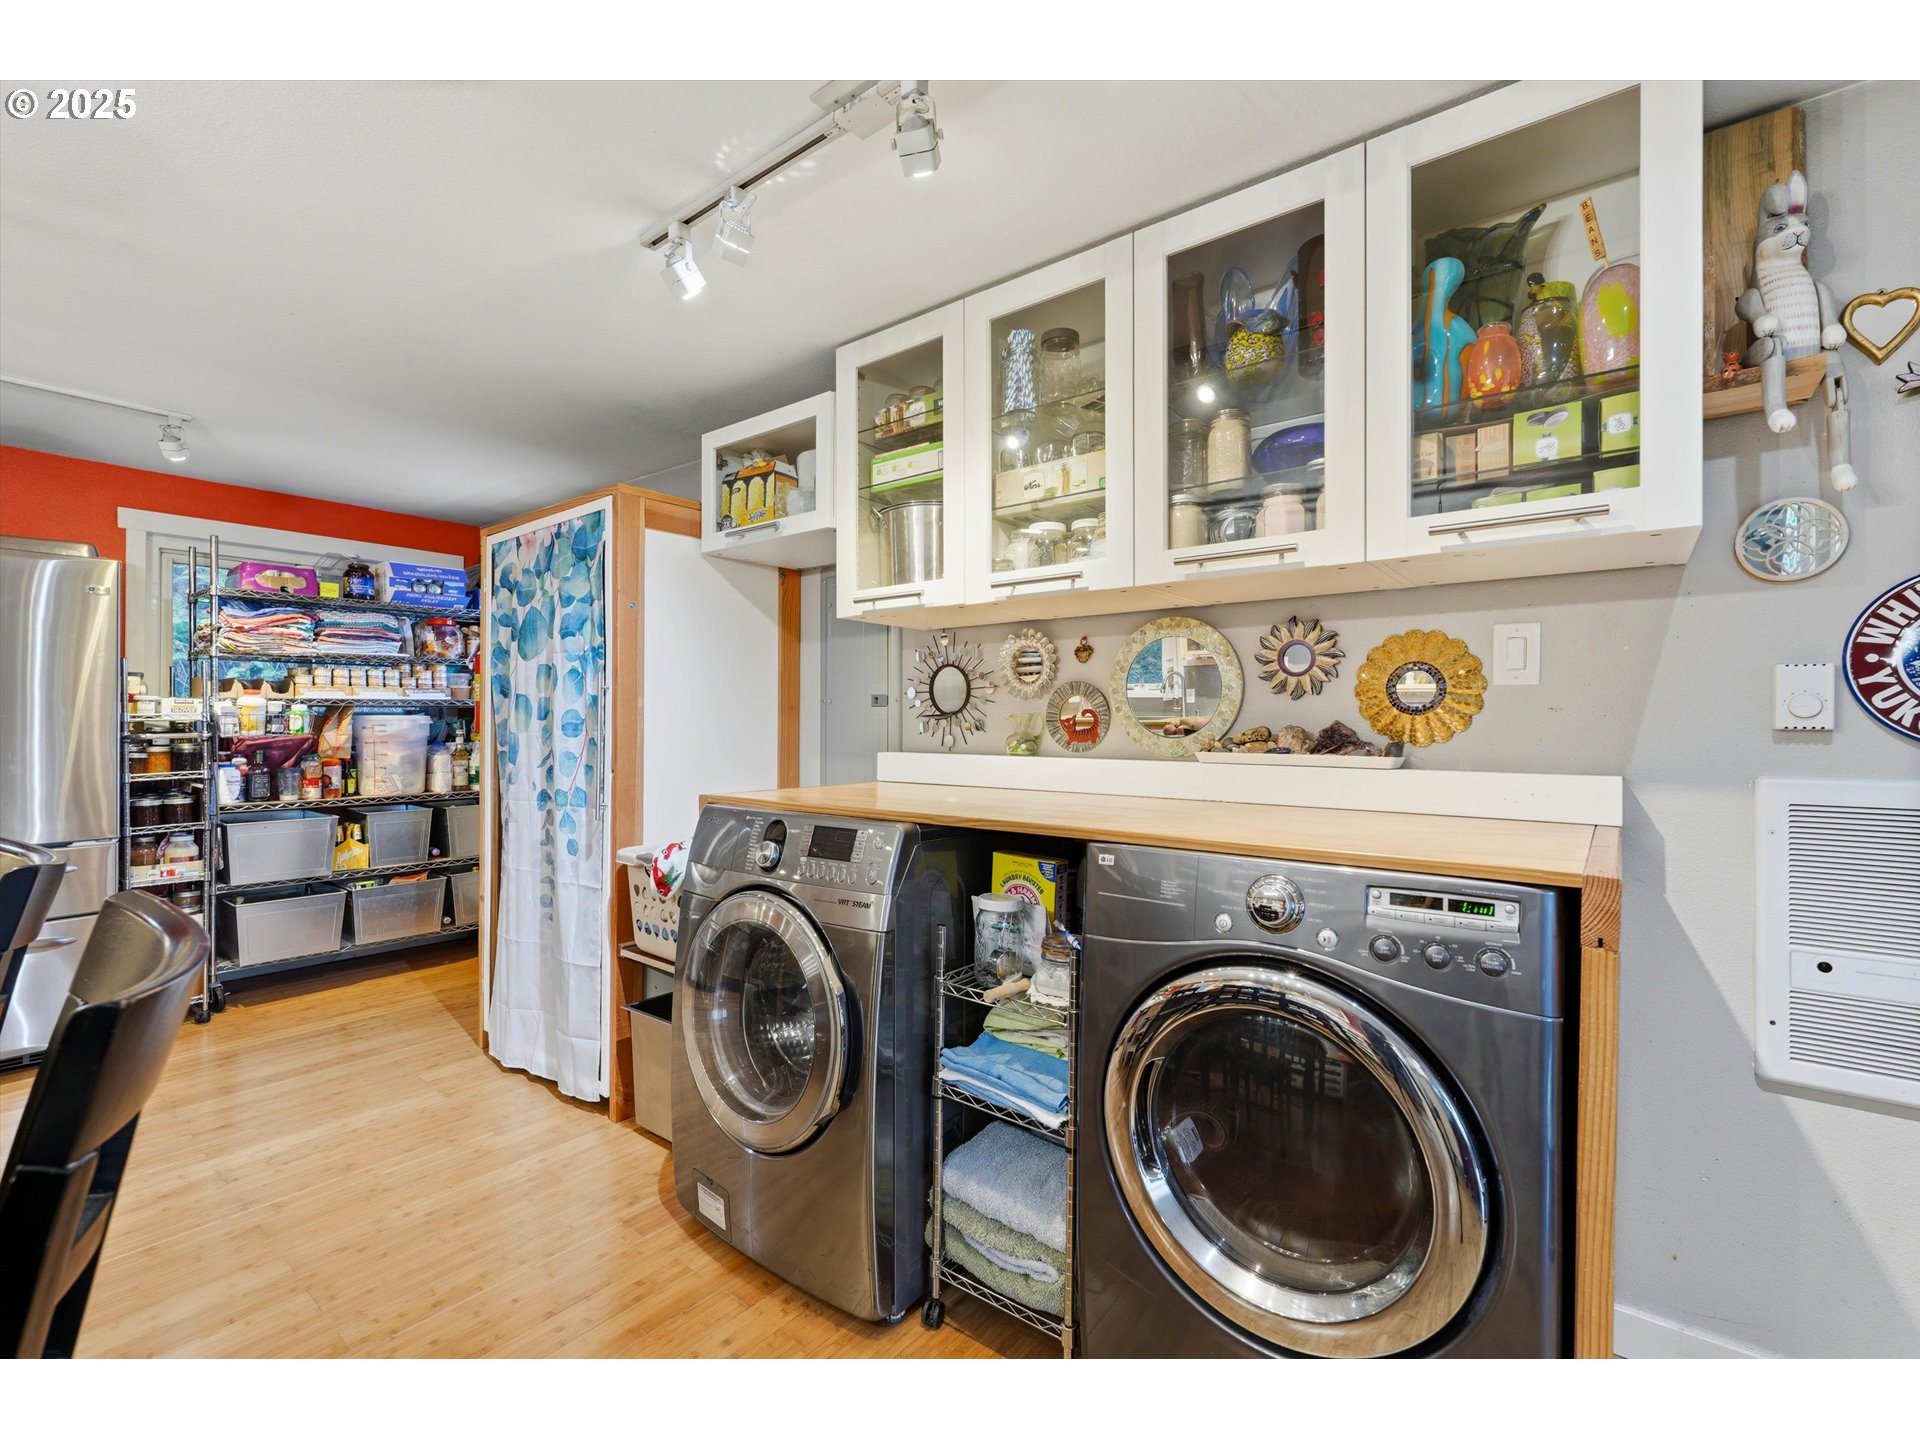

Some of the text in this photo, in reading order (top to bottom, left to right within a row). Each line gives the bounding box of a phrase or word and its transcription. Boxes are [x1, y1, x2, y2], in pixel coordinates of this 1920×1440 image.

[1581, 201, 1602, 257] BEANS
[1857, 666, 1920, 728] YUK
[837, 898, 850, 906] VRT
[851, 900, 872, 909] STEAM
[999, 873, 1022, 888] LAUNDRY
[1022, 874, 1045, 895] BOOSTER
